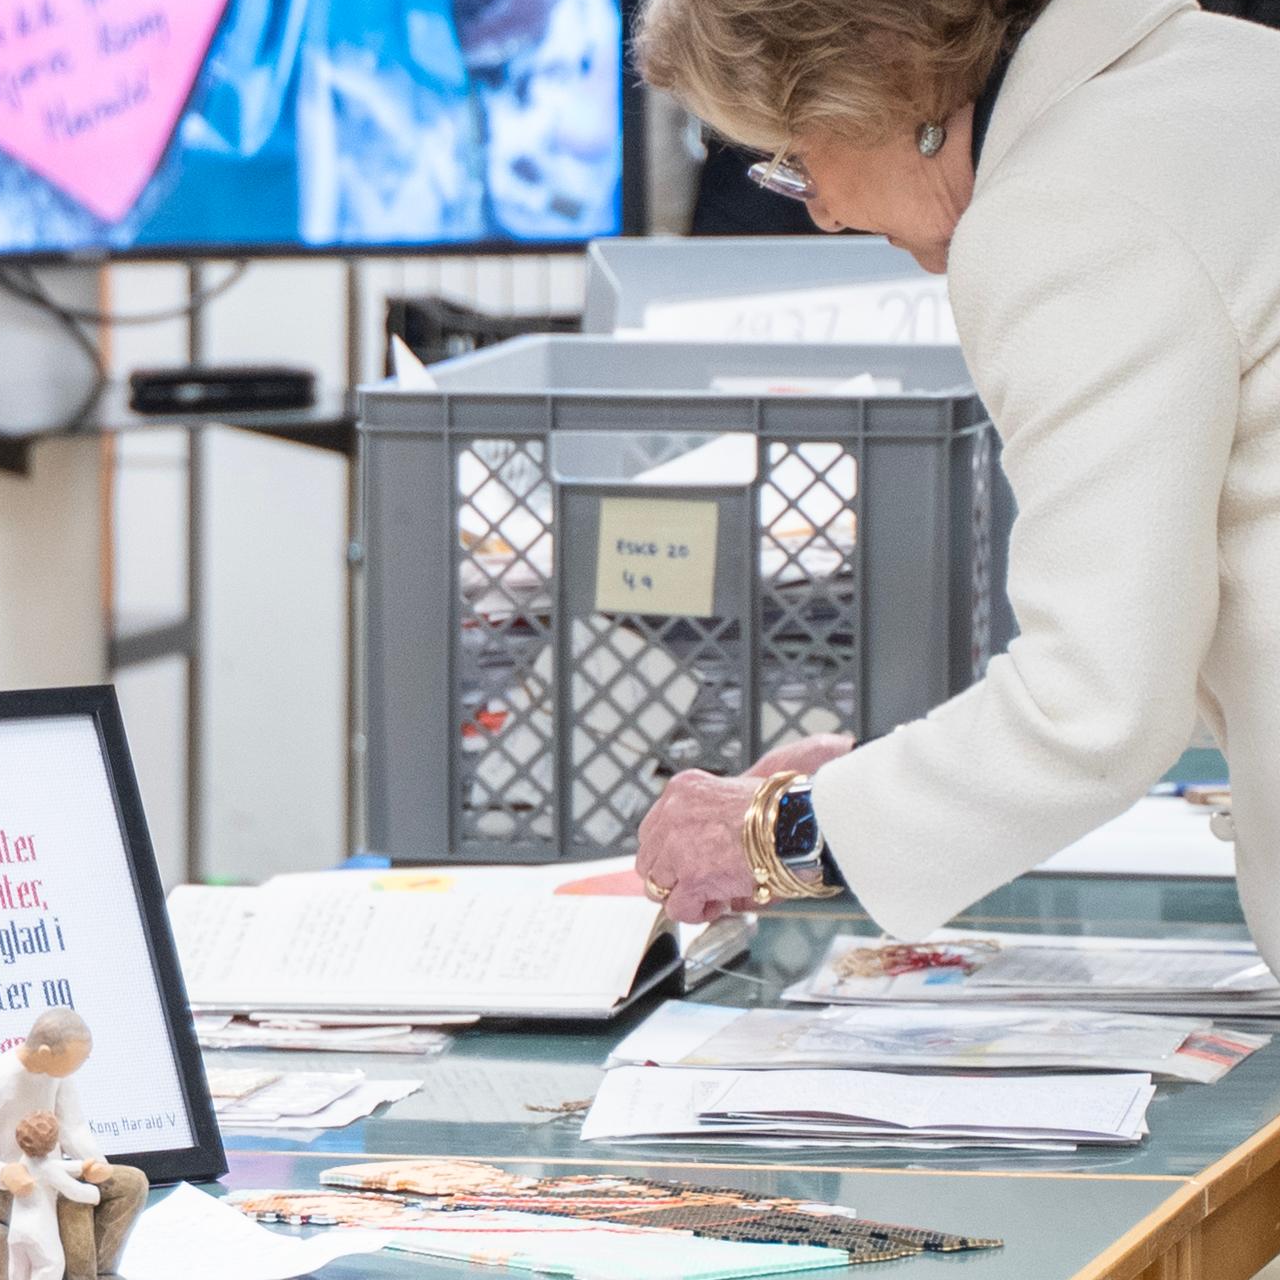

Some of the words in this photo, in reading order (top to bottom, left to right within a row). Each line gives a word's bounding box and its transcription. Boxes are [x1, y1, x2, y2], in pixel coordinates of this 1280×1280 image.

[53, 917, 66, 952] i
[88, 1119, 120, 1137] Kong
[122, 1111, 164, 1132] Harald
